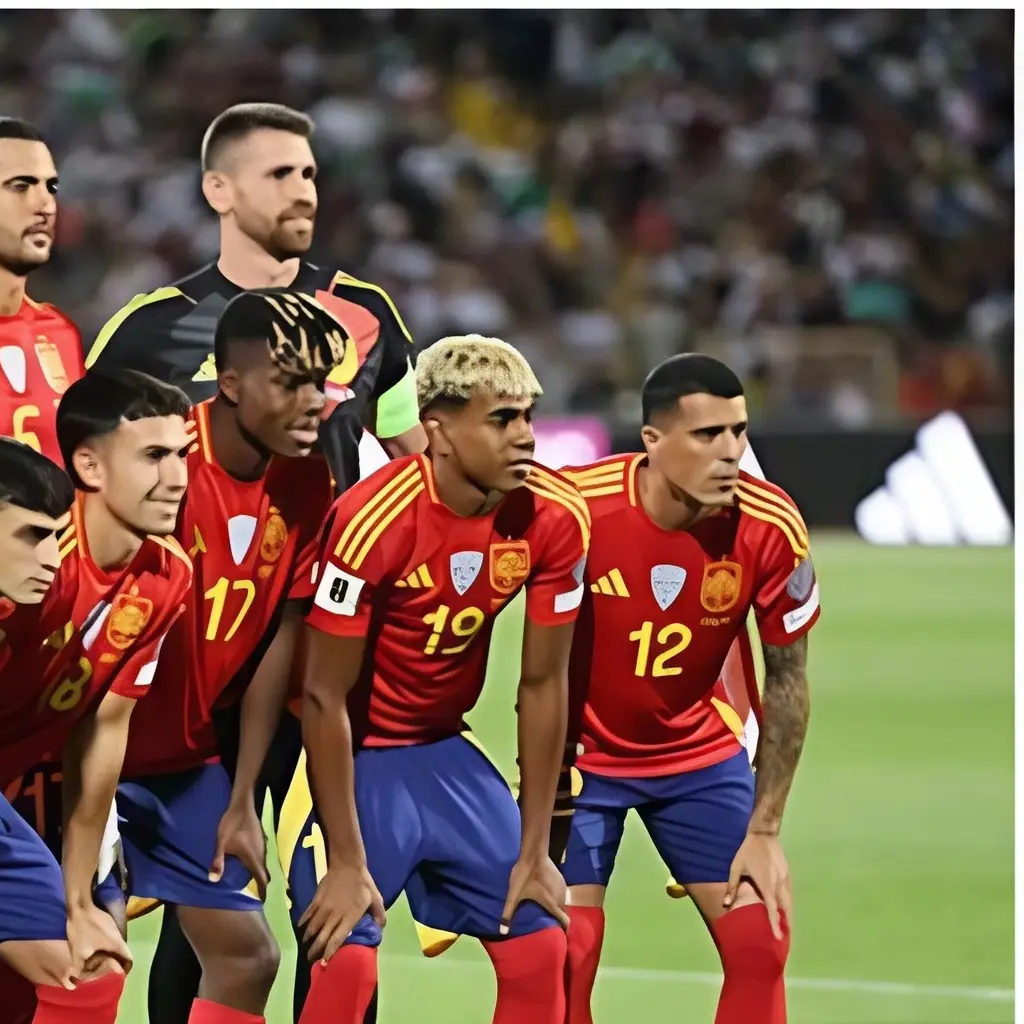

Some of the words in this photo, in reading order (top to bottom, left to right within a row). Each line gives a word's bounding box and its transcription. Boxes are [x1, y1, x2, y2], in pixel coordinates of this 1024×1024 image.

[204, 577, 256, 641] 17
[422, 604, 485, 655] 19
[629, 621, 692, 677] 12
